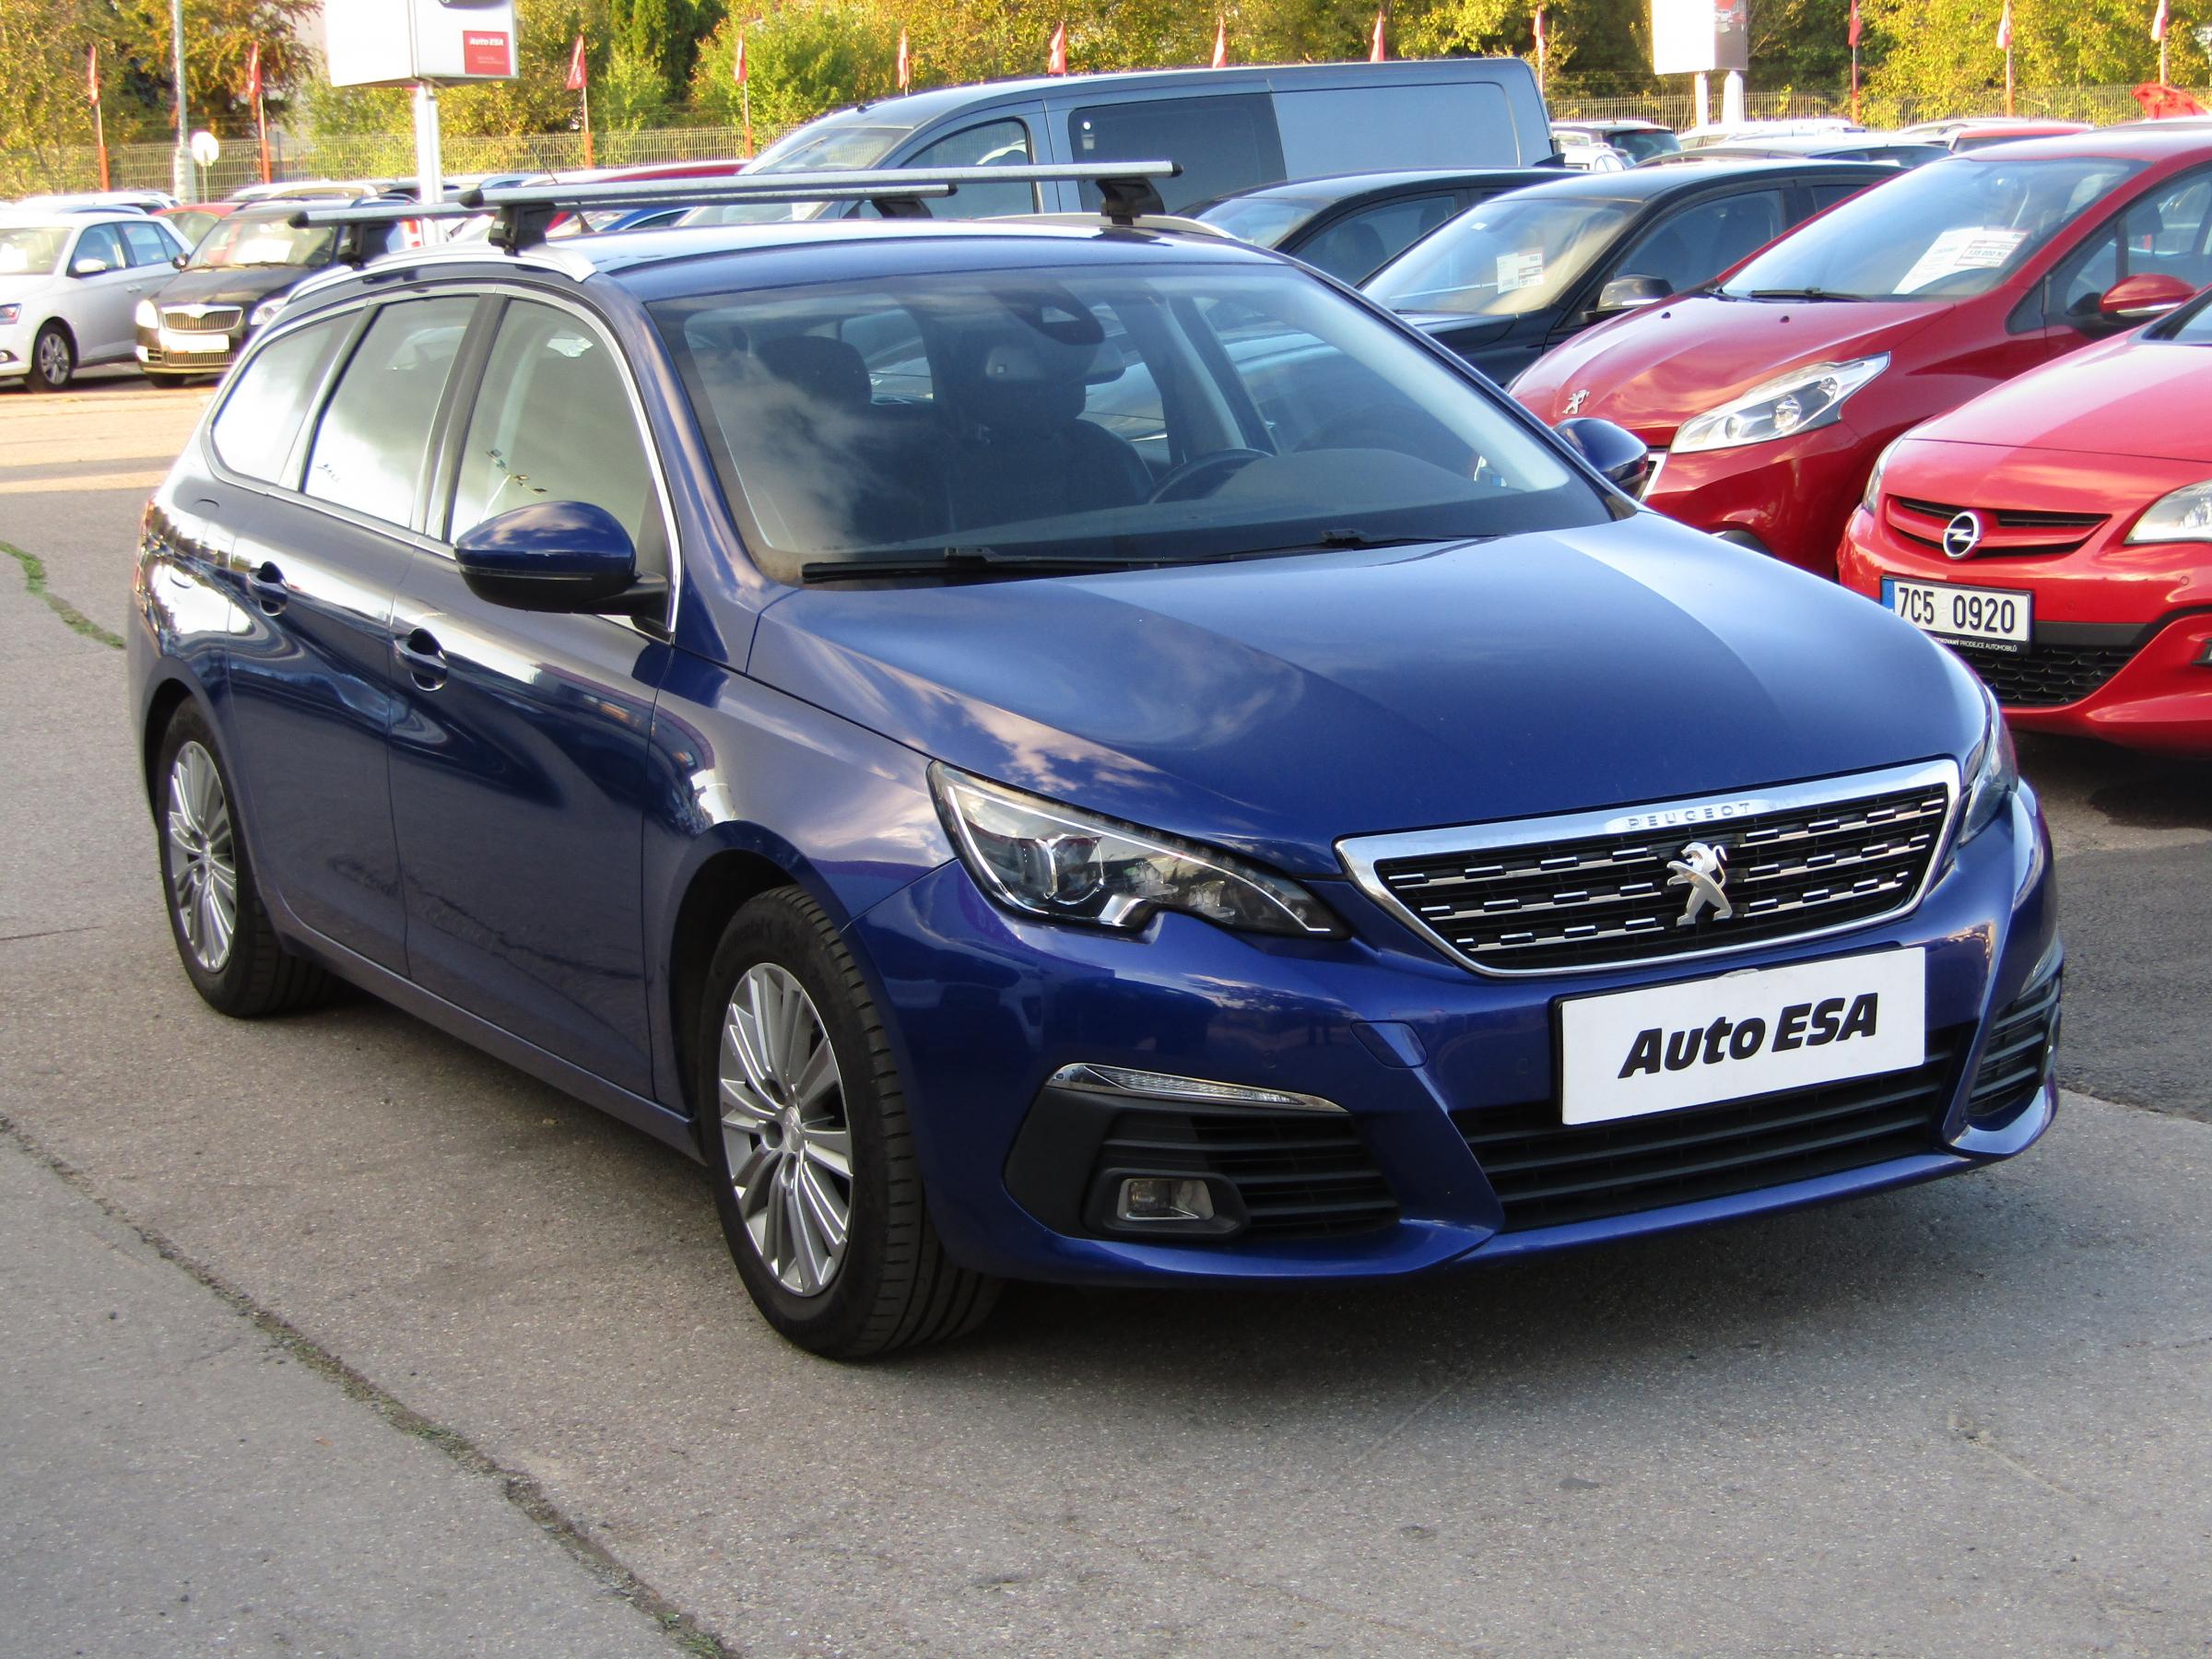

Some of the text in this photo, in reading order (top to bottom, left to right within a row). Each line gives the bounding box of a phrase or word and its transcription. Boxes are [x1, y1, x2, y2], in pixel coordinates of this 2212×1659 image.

[1899, 588, 2015, 633] 7C5 0920
[1959, 640, 1984, 649] PRODEJCE
[1628, 803, 1749, 830] PEUGEOT
[1618, 993, 1878, 1079] Auto ESA
